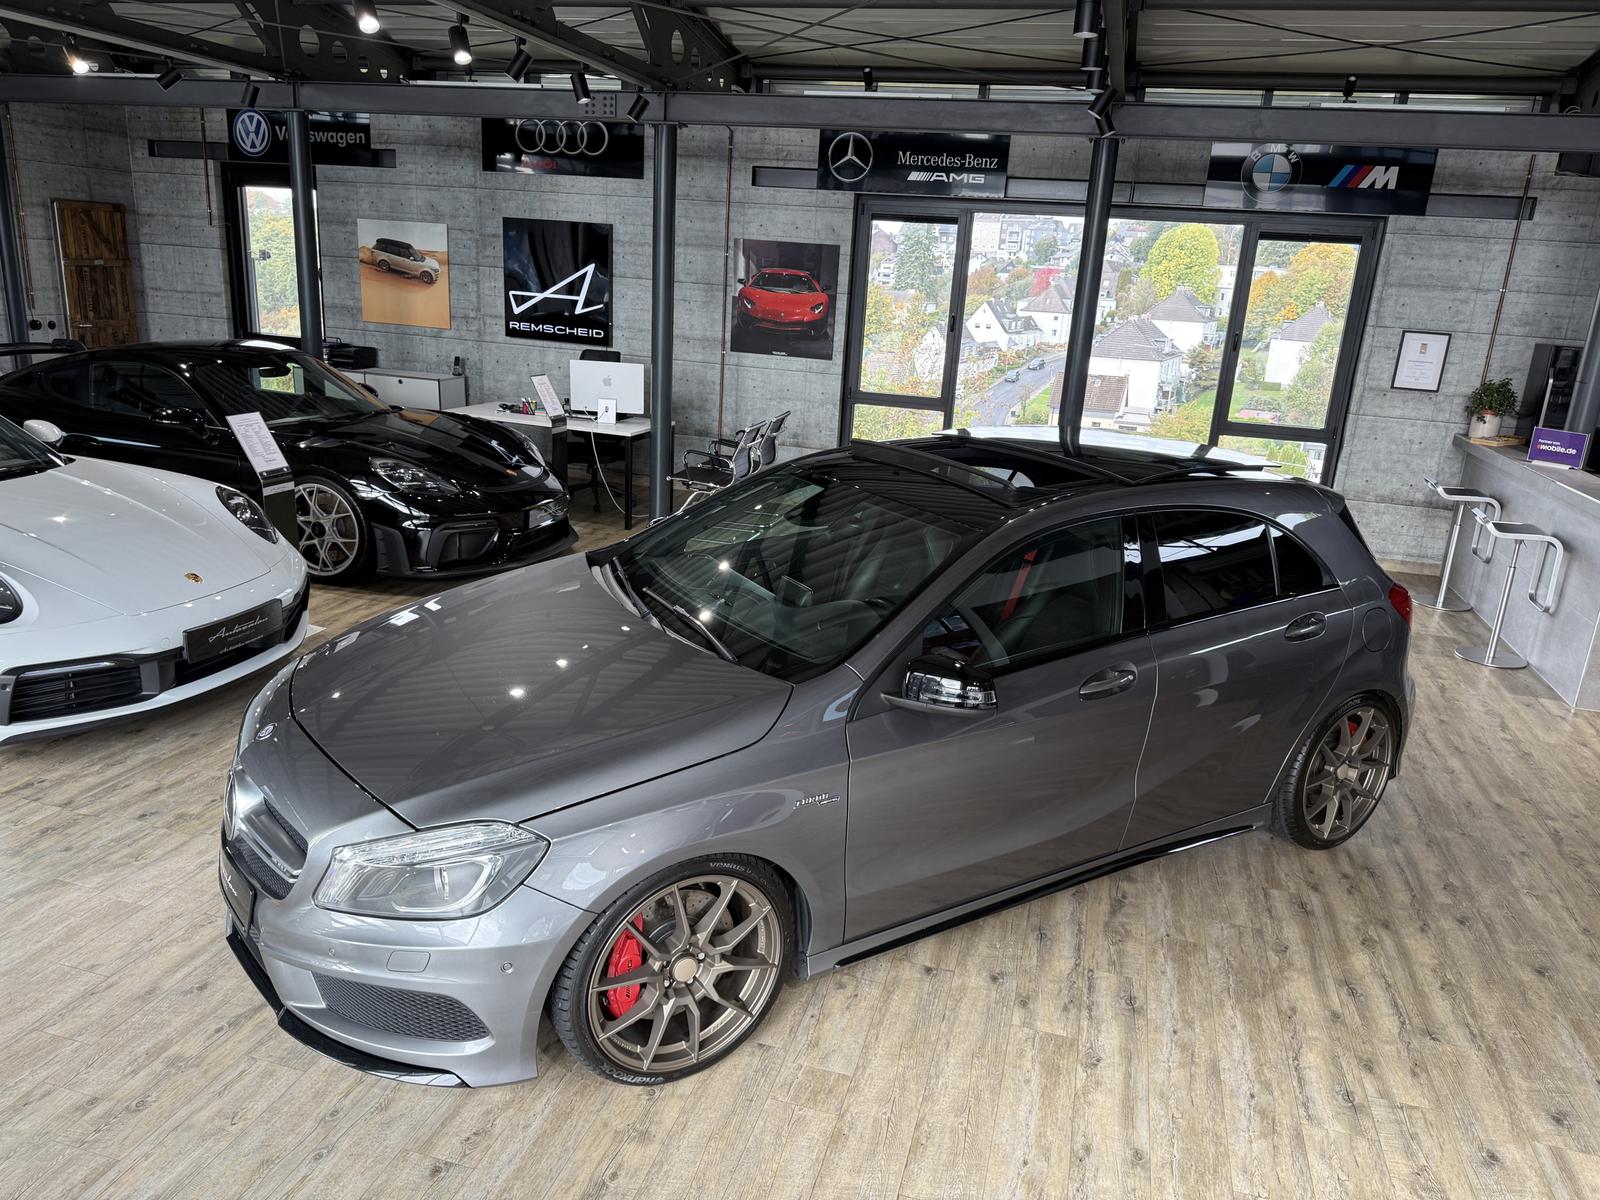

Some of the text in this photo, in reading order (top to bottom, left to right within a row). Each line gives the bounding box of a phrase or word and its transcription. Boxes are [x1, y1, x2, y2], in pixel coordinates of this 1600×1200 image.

[275, 125, 366, 147] Vswagen
[897, 151, 998, 169] Mercedes-Benz
[930, 172, 985, 184] AMG
[509, 321, 604, 338] REMSCHEID
